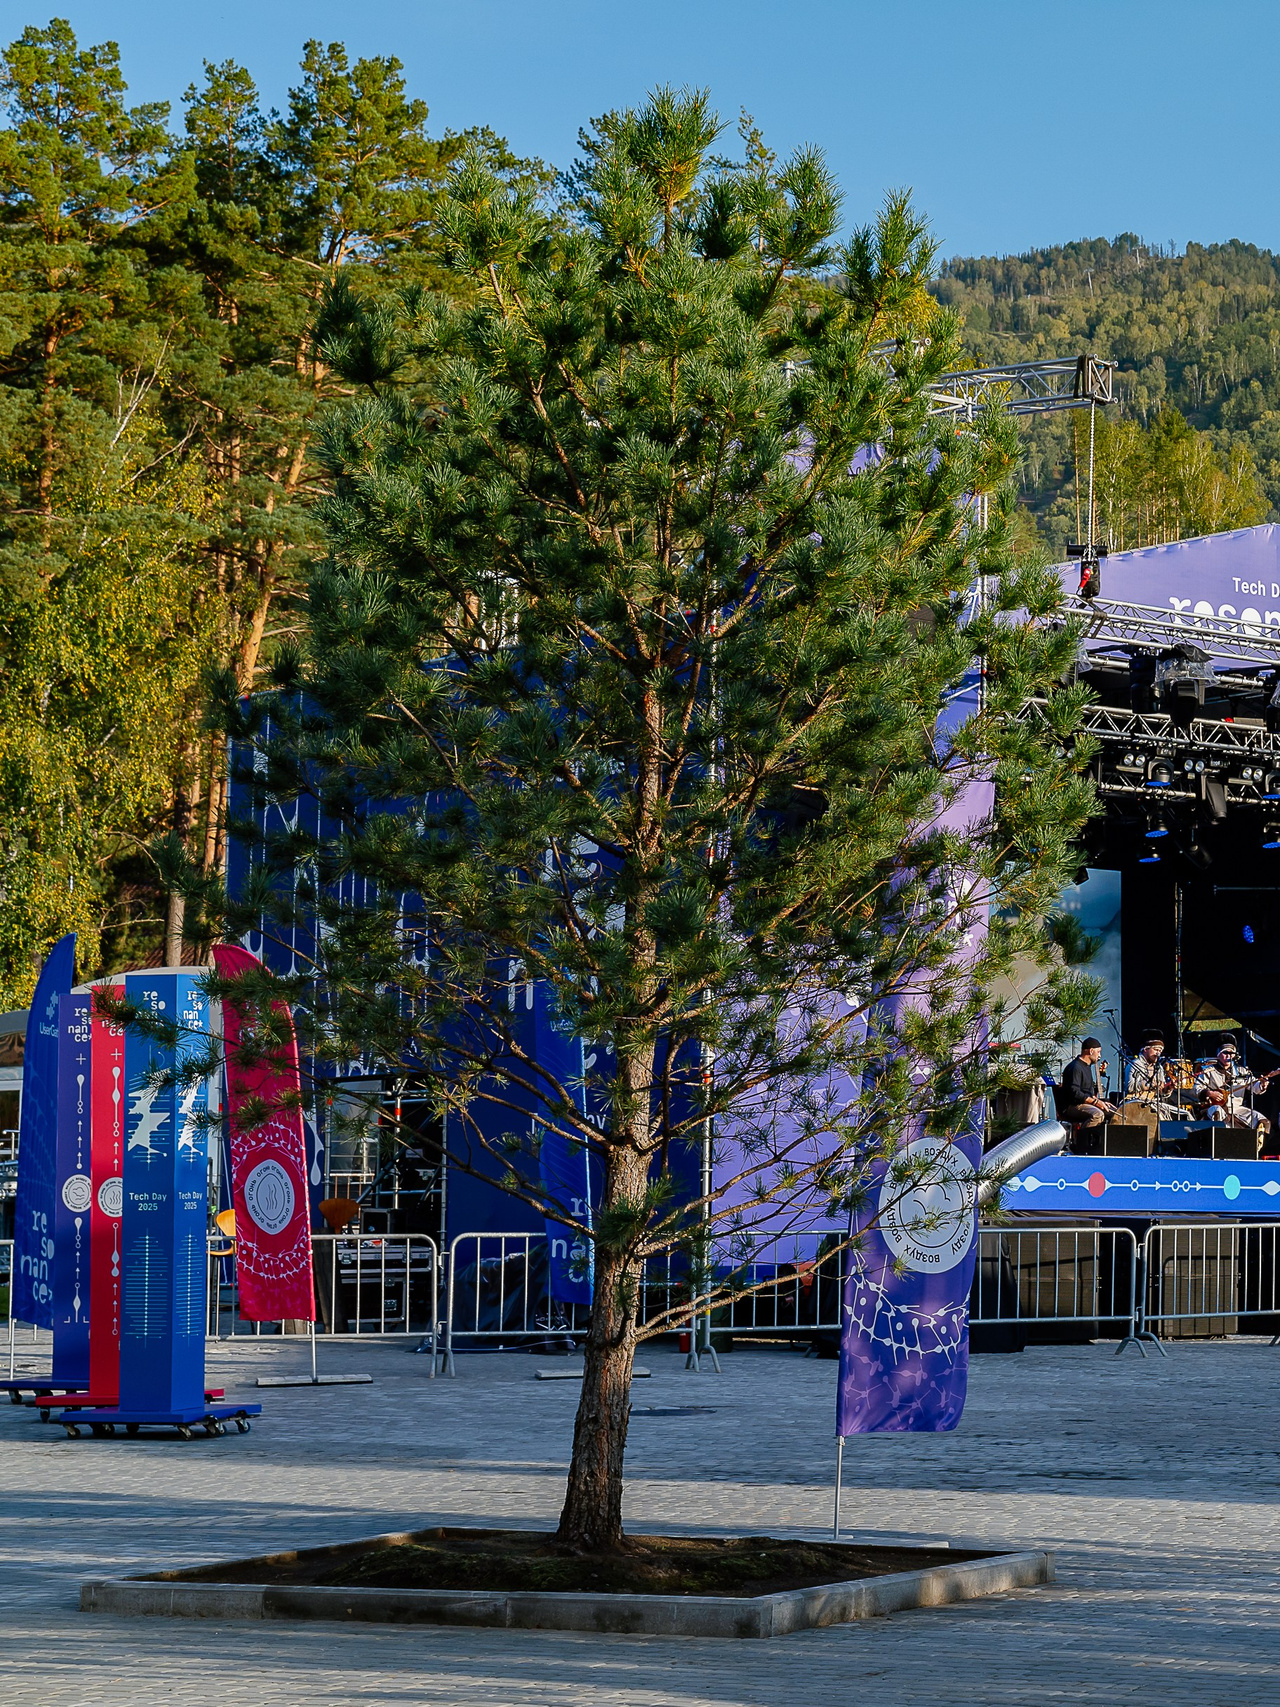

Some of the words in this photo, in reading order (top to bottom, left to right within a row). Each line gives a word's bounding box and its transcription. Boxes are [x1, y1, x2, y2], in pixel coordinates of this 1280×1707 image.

[1232, 577, 1266, 597] Tech
[142, 991, 158, 1000] re
[150, 1001, 166, 1010] so
[74, 1007, 88, 1017] re
[183, 1010, 199, 1020] nan
[67, 1025, 88, 1034] nan
[129, 1193, 149, 1201] Tech
[152, 1193, 168, 1202] Day
[178, 1192, 191, 1200] Tech
[192, 1192, 203, 1201] Day
[138, 1203, 158, 1211] 2025
[184, 1202, 197, 1210] 2025
[32, 1210, 47, 1234] re
[40, 1236, 55, 1260] so
[904, 1244, 940, 1263] воздух
[20, 1254, 48, 1281] nan
